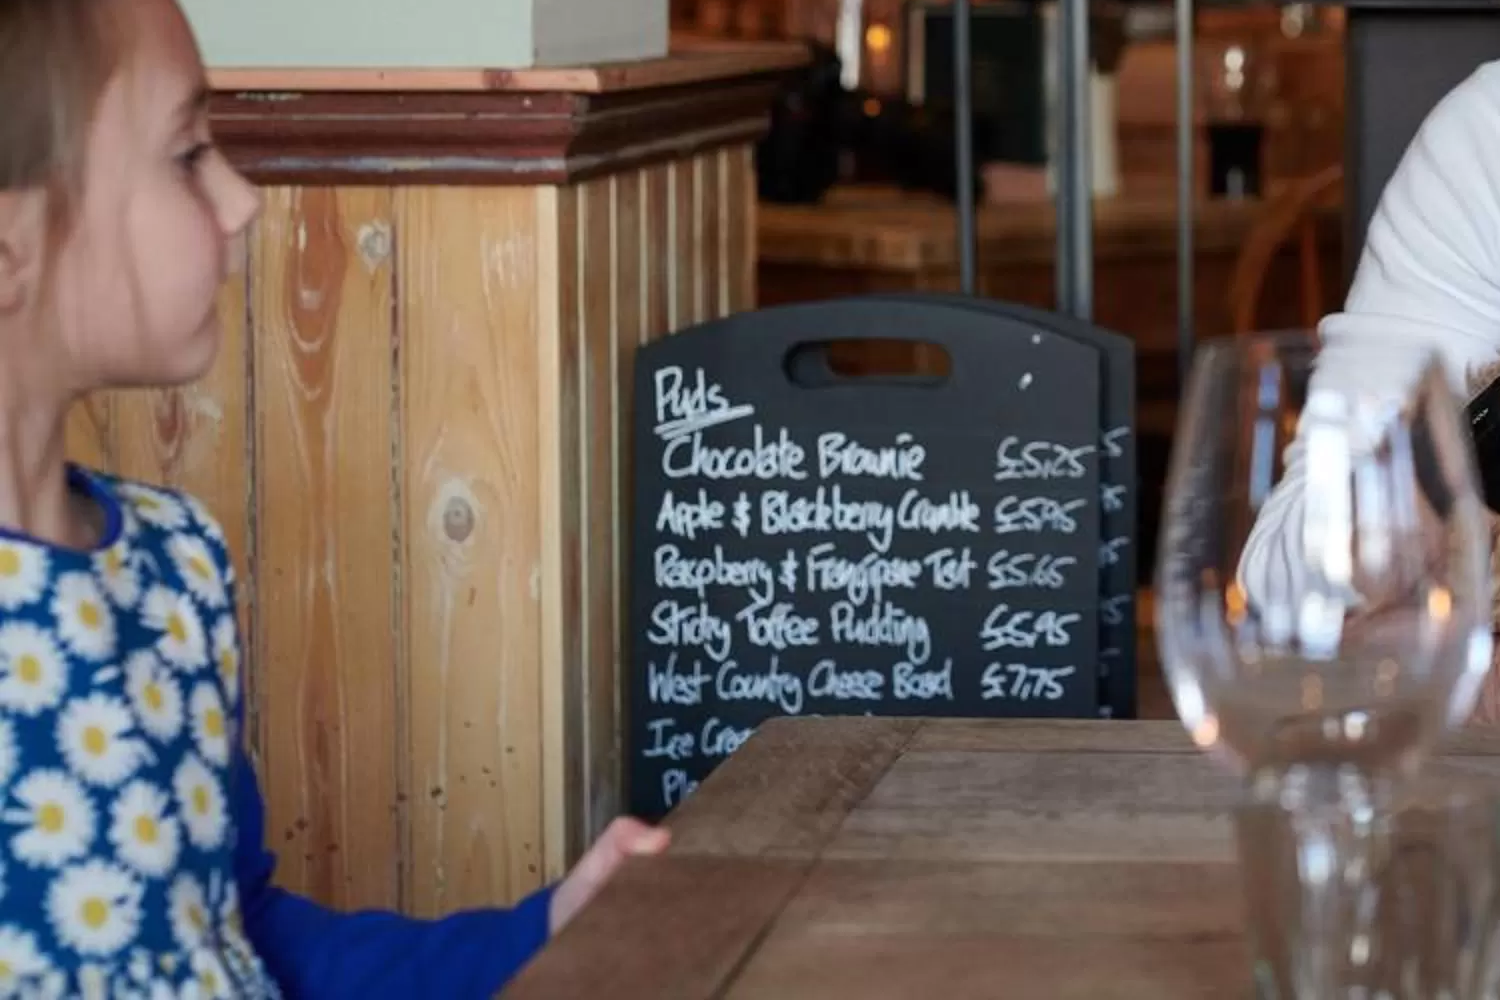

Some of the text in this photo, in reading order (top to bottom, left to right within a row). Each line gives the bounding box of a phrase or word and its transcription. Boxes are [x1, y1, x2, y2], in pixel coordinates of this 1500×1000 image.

[662, 424, 807, 479] Chocolate
[817, 432, 926, 481] Brownie
[655, 488, 725, 540] Apple
[761, 484, 893, 553] Blackberry
[654, 544, 775, 608] Raspberry
[647, 600, 731, 662] Sticky
[735, 602, 819, 650] Toffee
[830, 600, 931, 665] Pudding
[648, 652, 712, 704] West
[807, 659, 884, 699] Cheese
[643, 718, 695, 760] Ice
